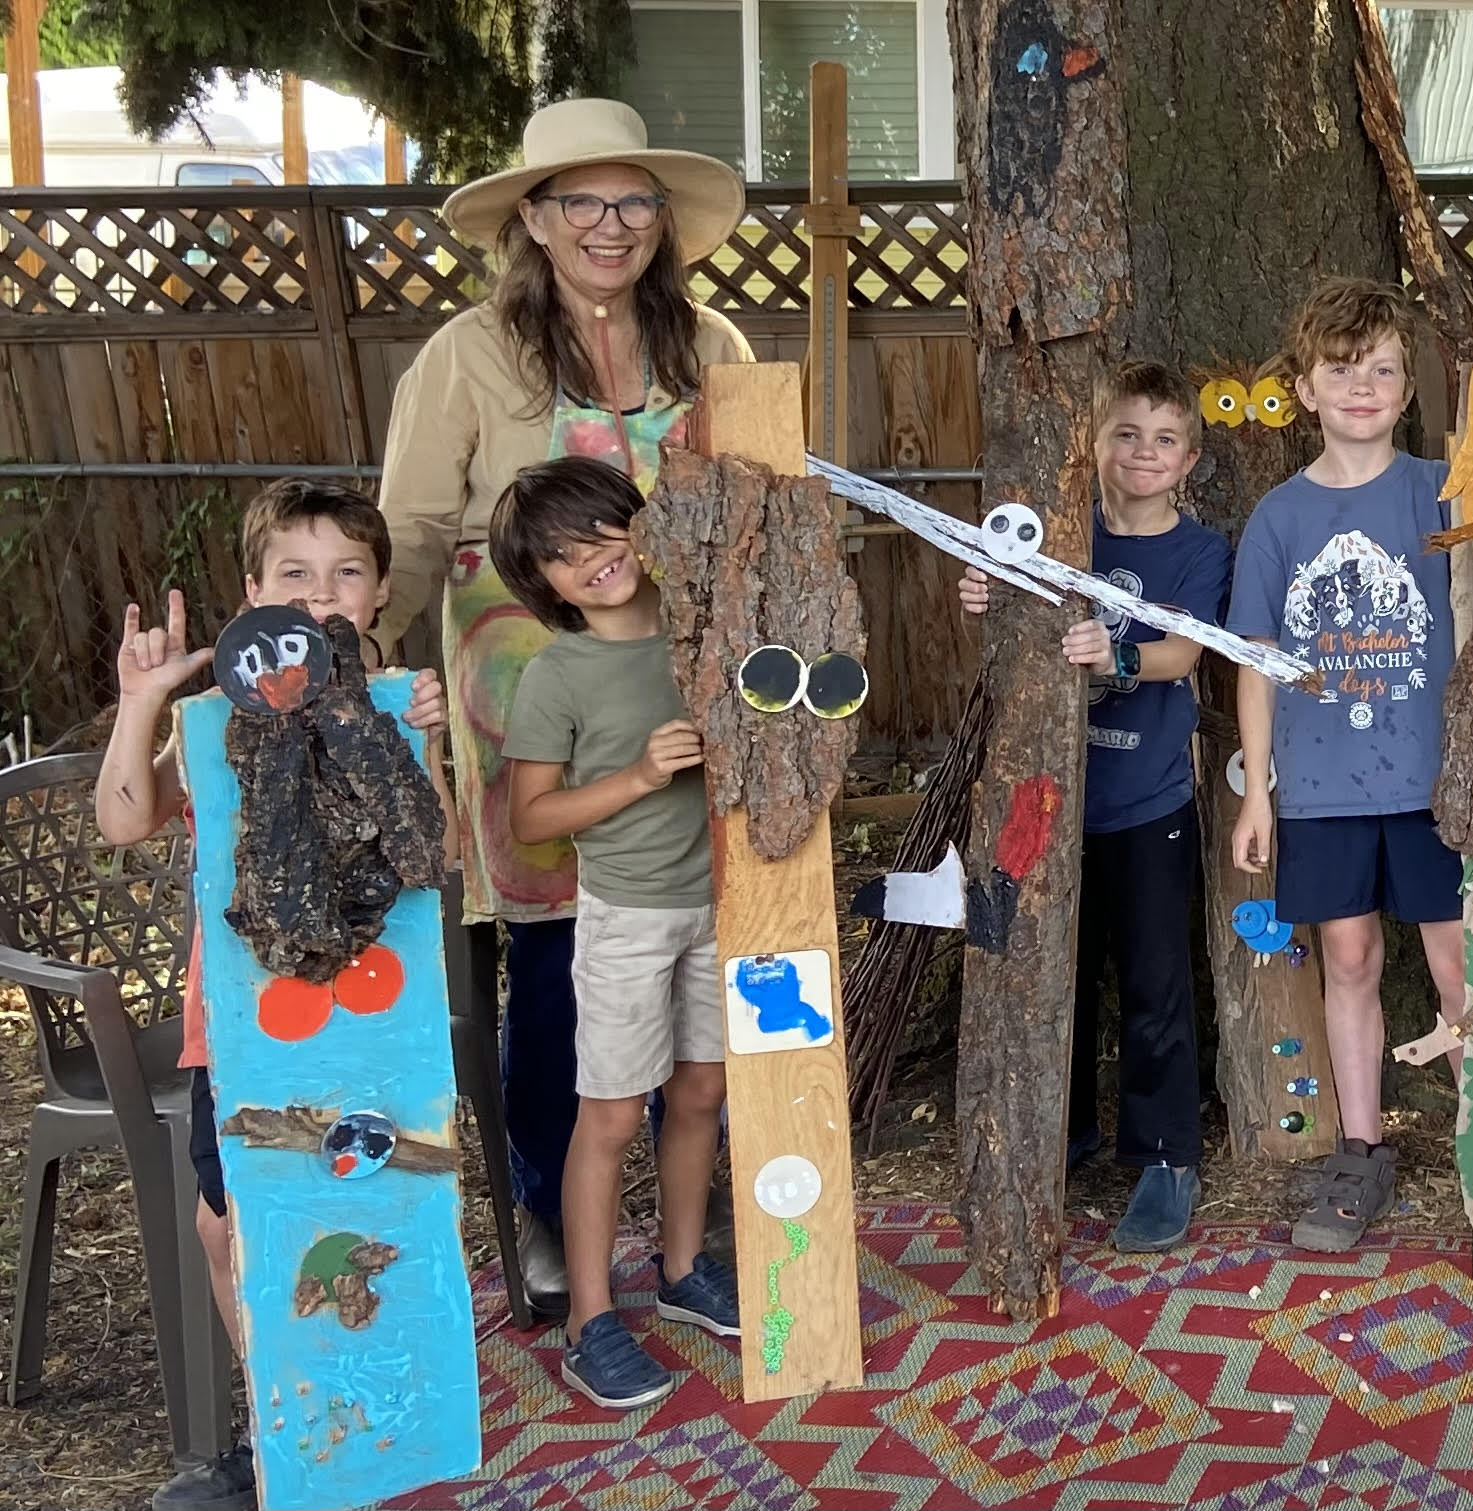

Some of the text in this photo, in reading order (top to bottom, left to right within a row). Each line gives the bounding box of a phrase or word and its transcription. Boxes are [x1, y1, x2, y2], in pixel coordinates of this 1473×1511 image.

[1341, 629, 1408, 654] Bachelor
[1318, 652, 1412, 671] AVALANCHE
[1339, 667, 1387, 701] dogs
